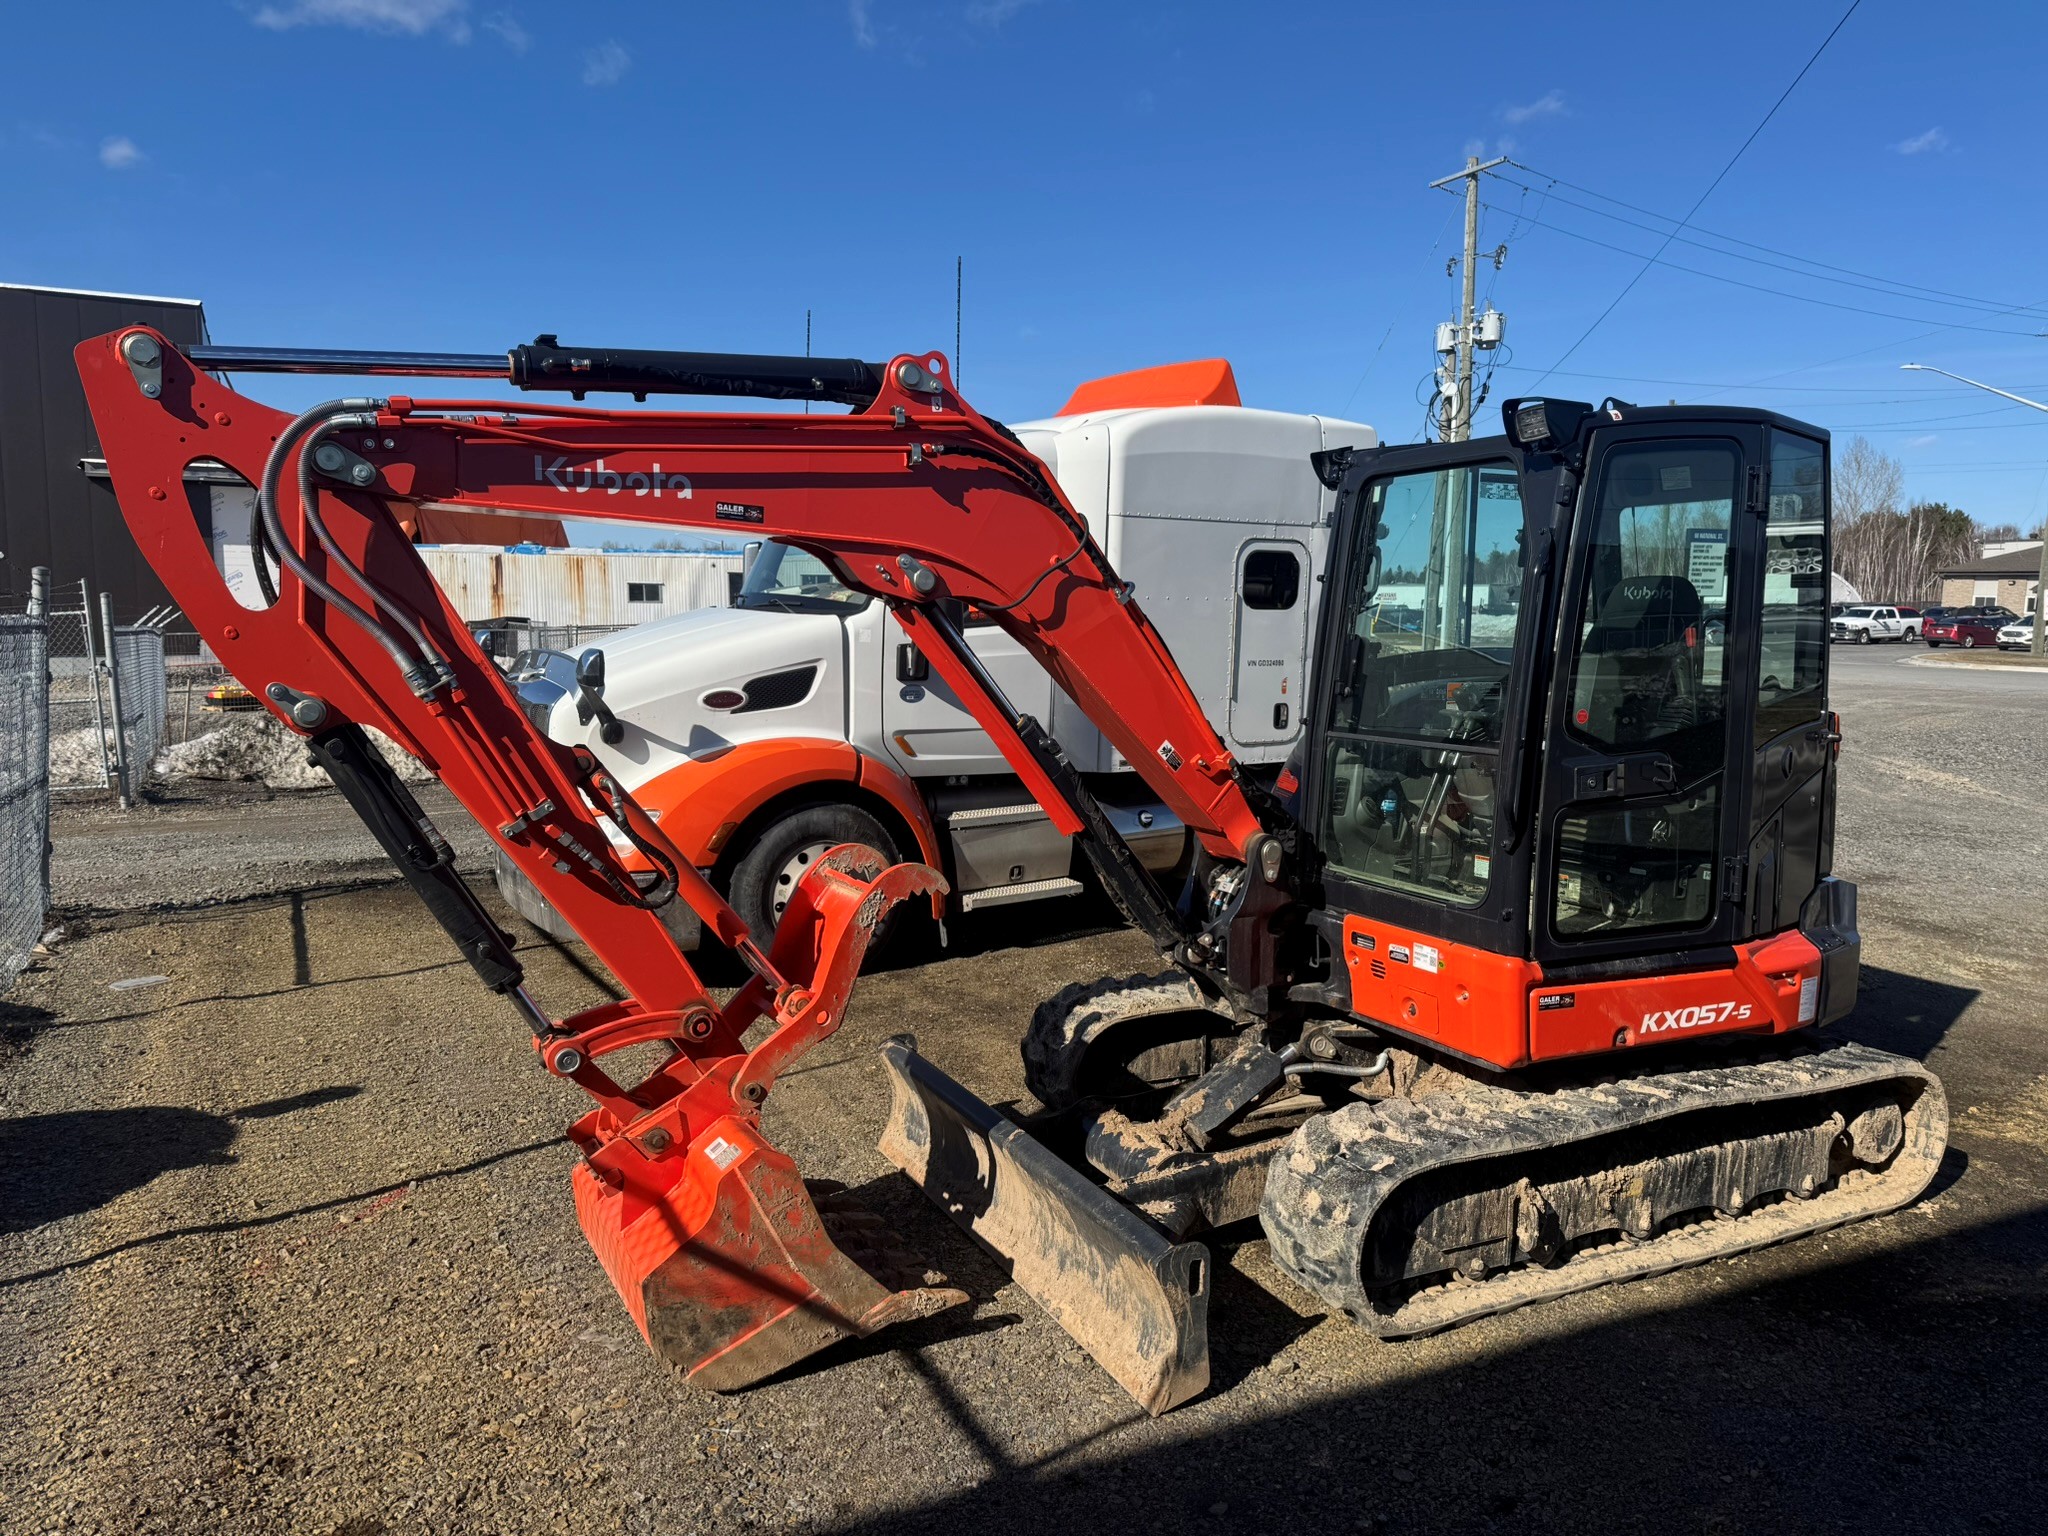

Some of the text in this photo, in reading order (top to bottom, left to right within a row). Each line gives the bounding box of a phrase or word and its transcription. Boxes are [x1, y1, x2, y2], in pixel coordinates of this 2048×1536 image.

[534, 454, 692, 500] Kubota
[716, 503, 744, 512] GALER
[1624, 586, 1672, 599] Kubota
[1539, 995, 1560, 1003] GALER
[1640, 1001, 1752, 1034] KX057-5
